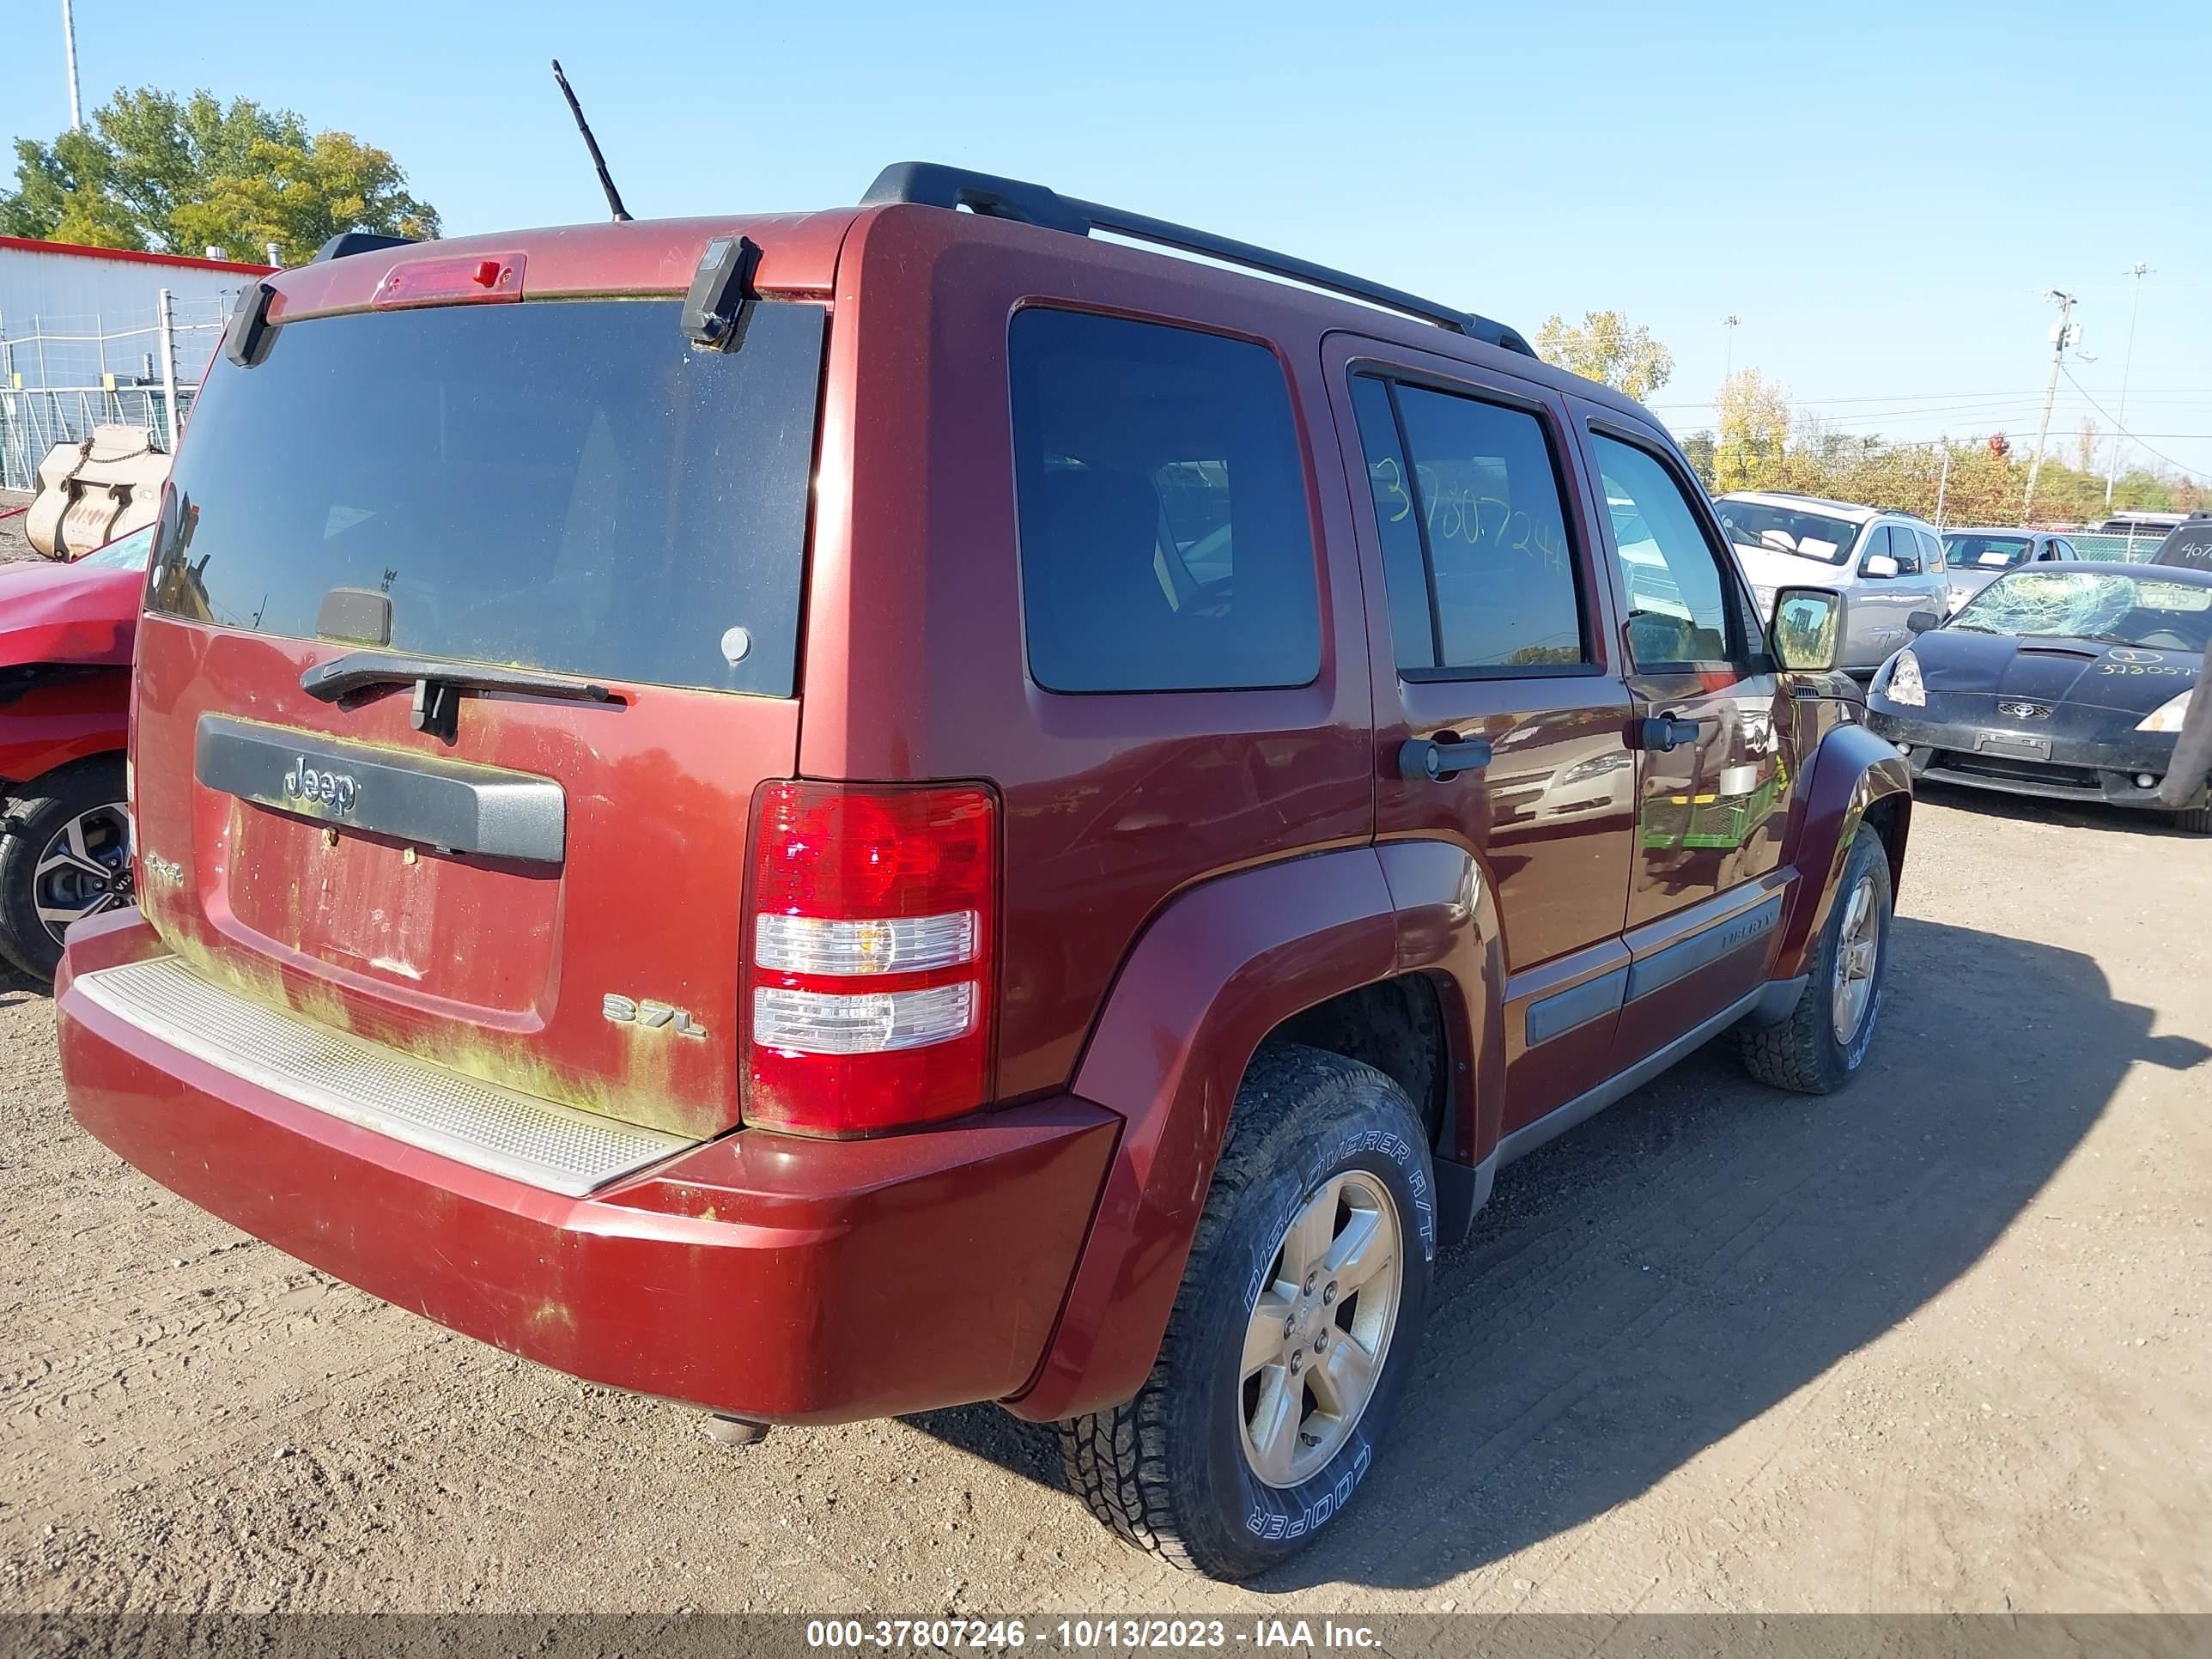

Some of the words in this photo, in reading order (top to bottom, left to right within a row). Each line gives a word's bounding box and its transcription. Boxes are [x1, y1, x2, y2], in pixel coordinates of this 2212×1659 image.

[284, 755, 356, 817] Jeep
[115, 874, 133, 891] KIA
[1722, 912, 1773, 949] LIBERTY
[1243, 1130, 1411, 1313] DISCOVERER
[1246, 1444, 1371, 1540] COOPER
